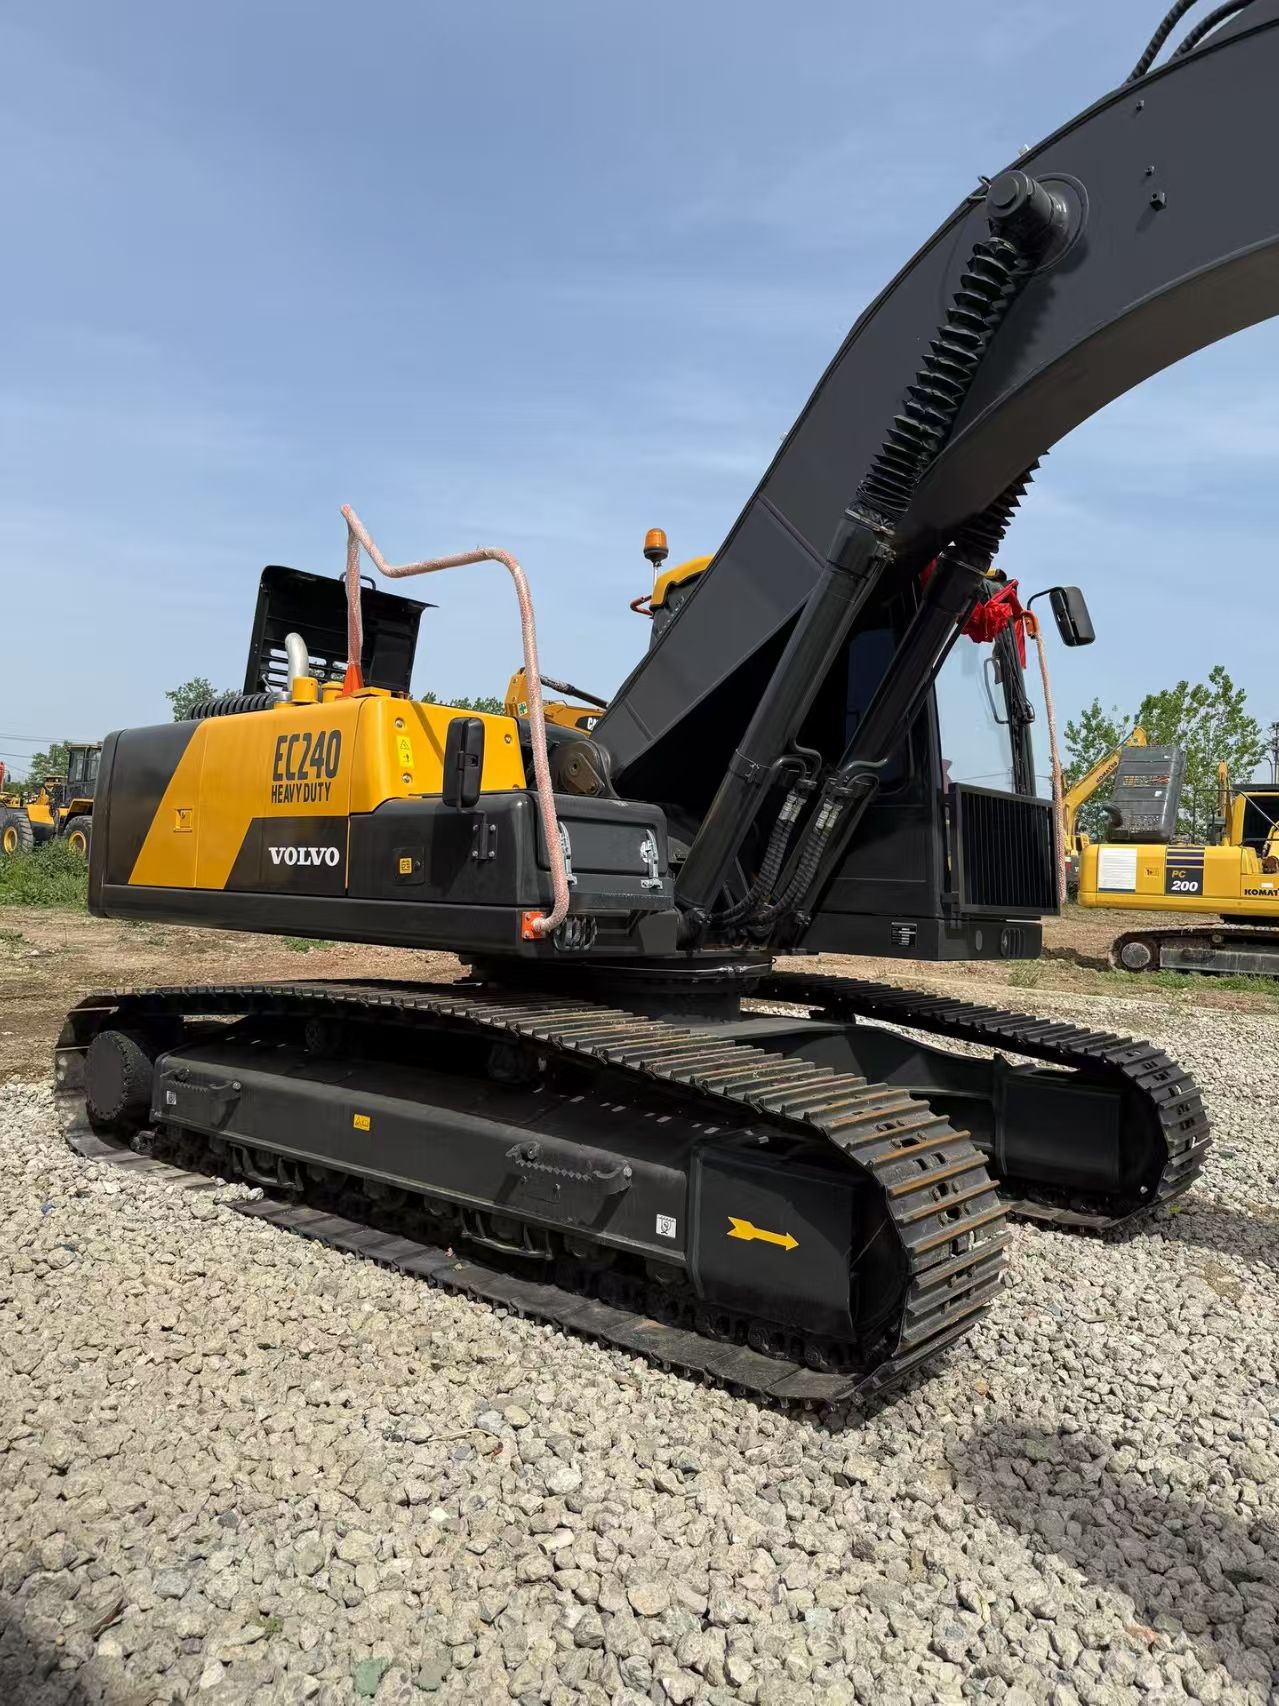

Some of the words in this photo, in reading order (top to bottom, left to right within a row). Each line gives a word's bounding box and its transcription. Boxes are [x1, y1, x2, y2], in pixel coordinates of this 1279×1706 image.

[272, 729, 342, 781] EC240
[271, 783, 303, 804] HEAVY
[303, 781, 332, 803] DUTY
[268, 847, 340, 867] VOLVO
[1171, 870, 1187, 878] PC
[1171, 880, 1198, 892] 200
